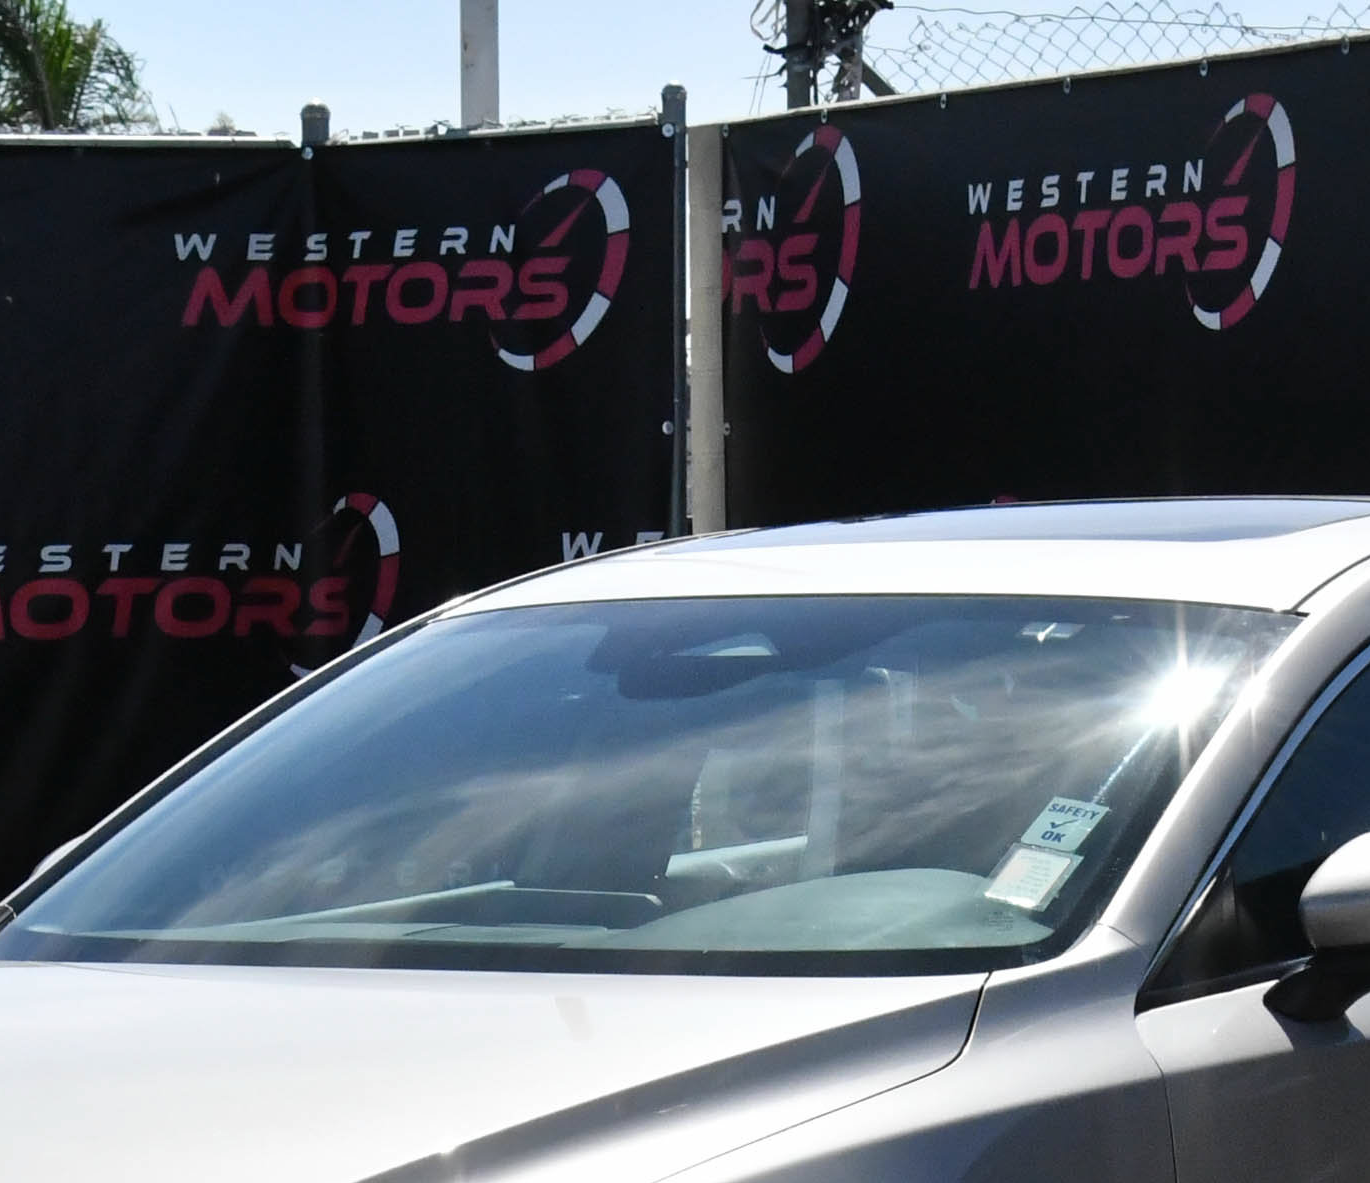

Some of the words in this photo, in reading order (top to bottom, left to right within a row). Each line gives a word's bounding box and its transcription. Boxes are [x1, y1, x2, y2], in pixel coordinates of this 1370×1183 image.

[967, 158, 1204, 215] WESTERN
[174, 224, 515, 261] WESTERN
[969, 195, 1250, 290] MOTORS
[181, 256, 569, 328] MOTORS
[722, 233, 819, 314] RS
[1041, 830, 1066, 843] OK
[1048, 803, 1100, 820] SAFETY
